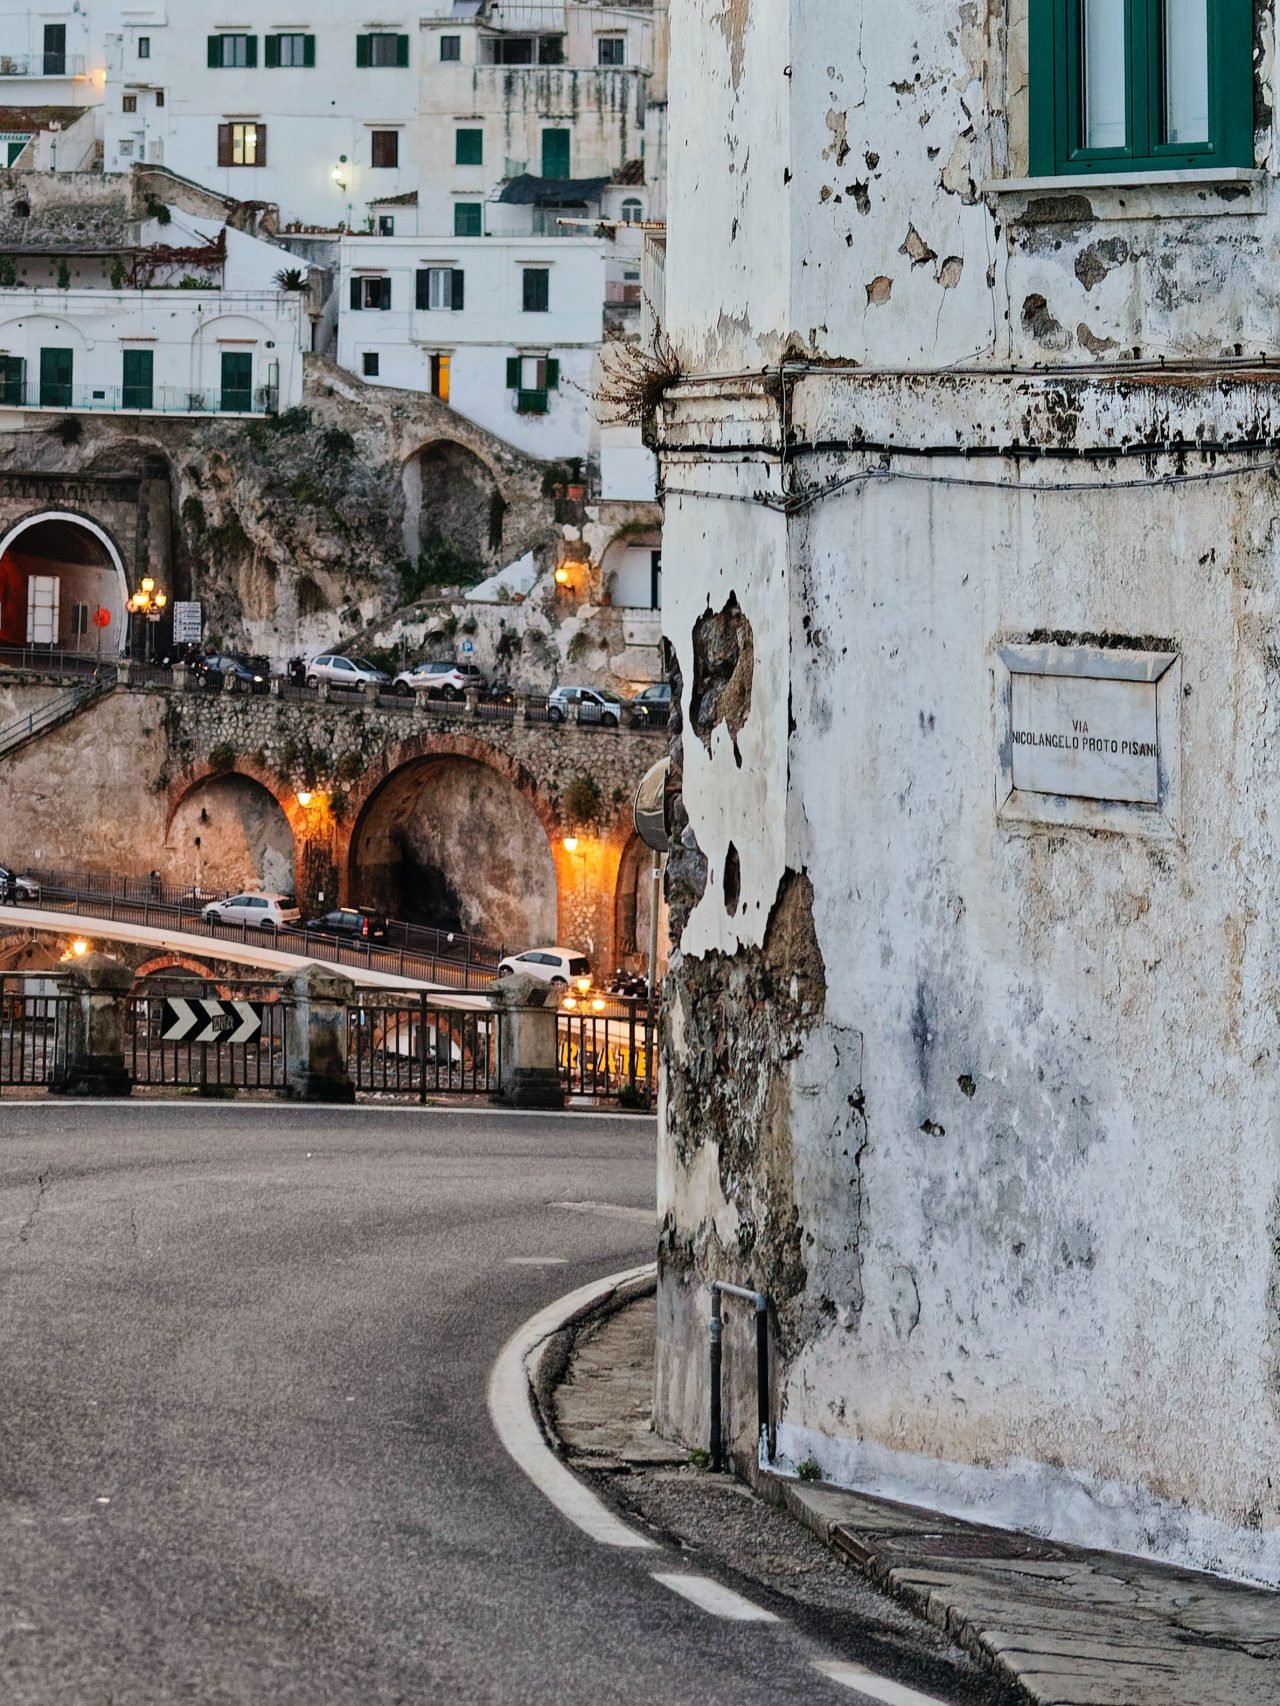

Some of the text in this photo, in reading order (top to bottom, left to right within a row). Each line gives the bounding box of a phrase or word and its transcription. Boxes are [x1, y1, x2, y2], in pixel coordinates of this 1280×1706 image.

[1072, 719, 1089, 734] VIA
[1012, 730, 1157, 758] NICOLANGELO PROTO PISANI
